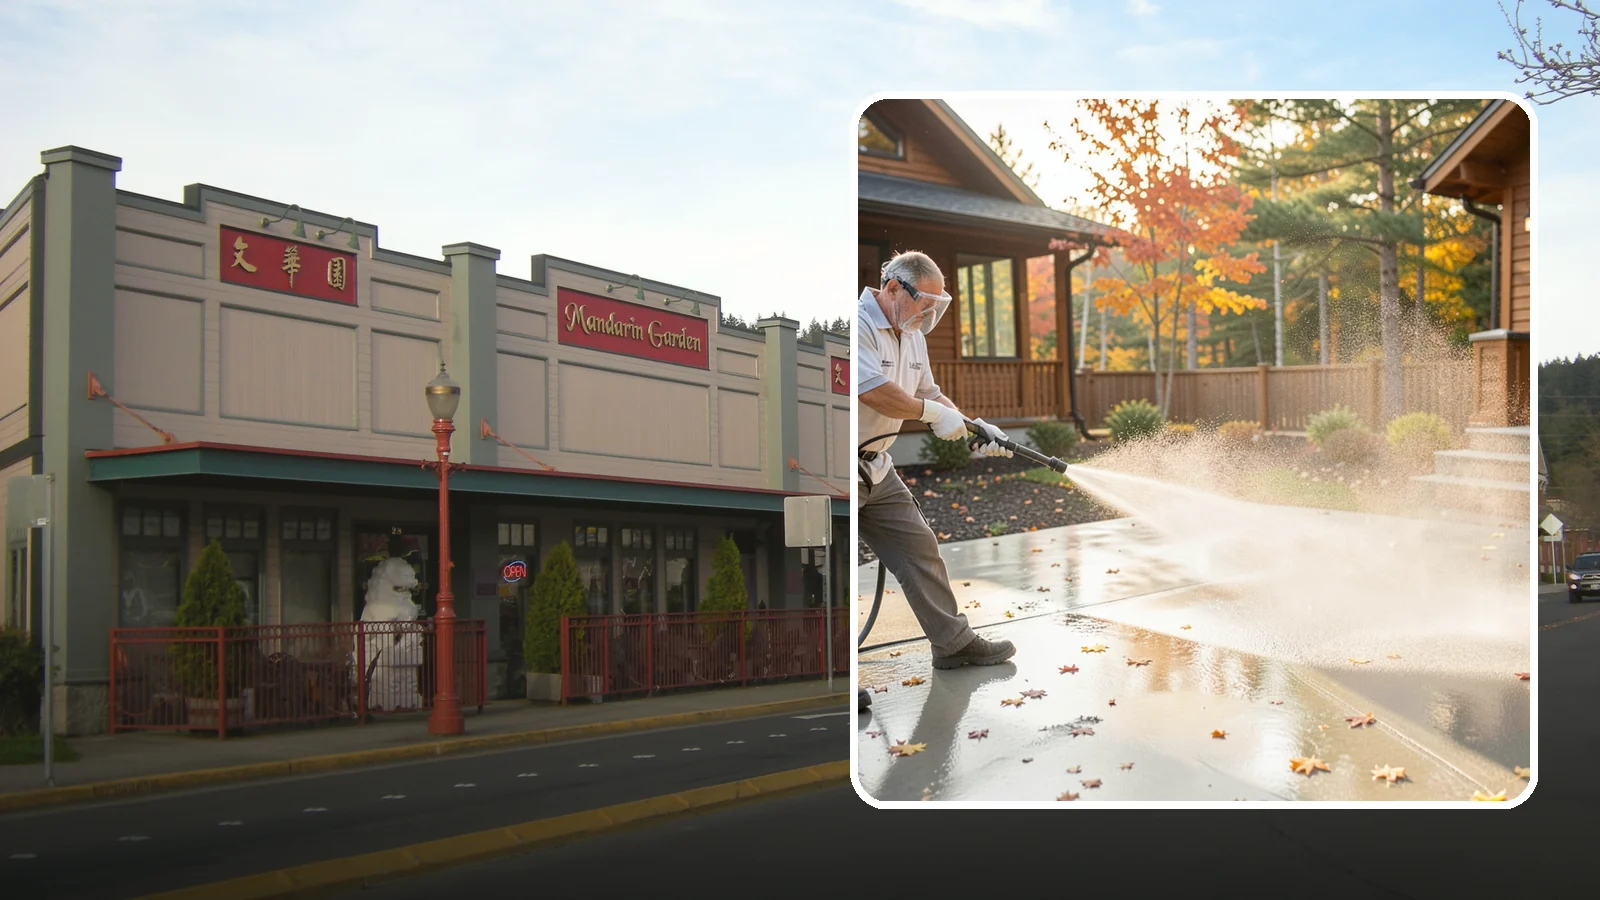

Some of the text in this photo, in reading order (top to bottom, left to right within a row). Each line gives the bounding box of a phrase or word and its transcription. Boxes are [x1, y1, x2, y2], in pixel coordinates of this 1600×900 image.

[564, 302, 702, 352] Mandarin Garden
[834, 363, 847, 386] 文
[503, 565, 527, 578] OPEN
